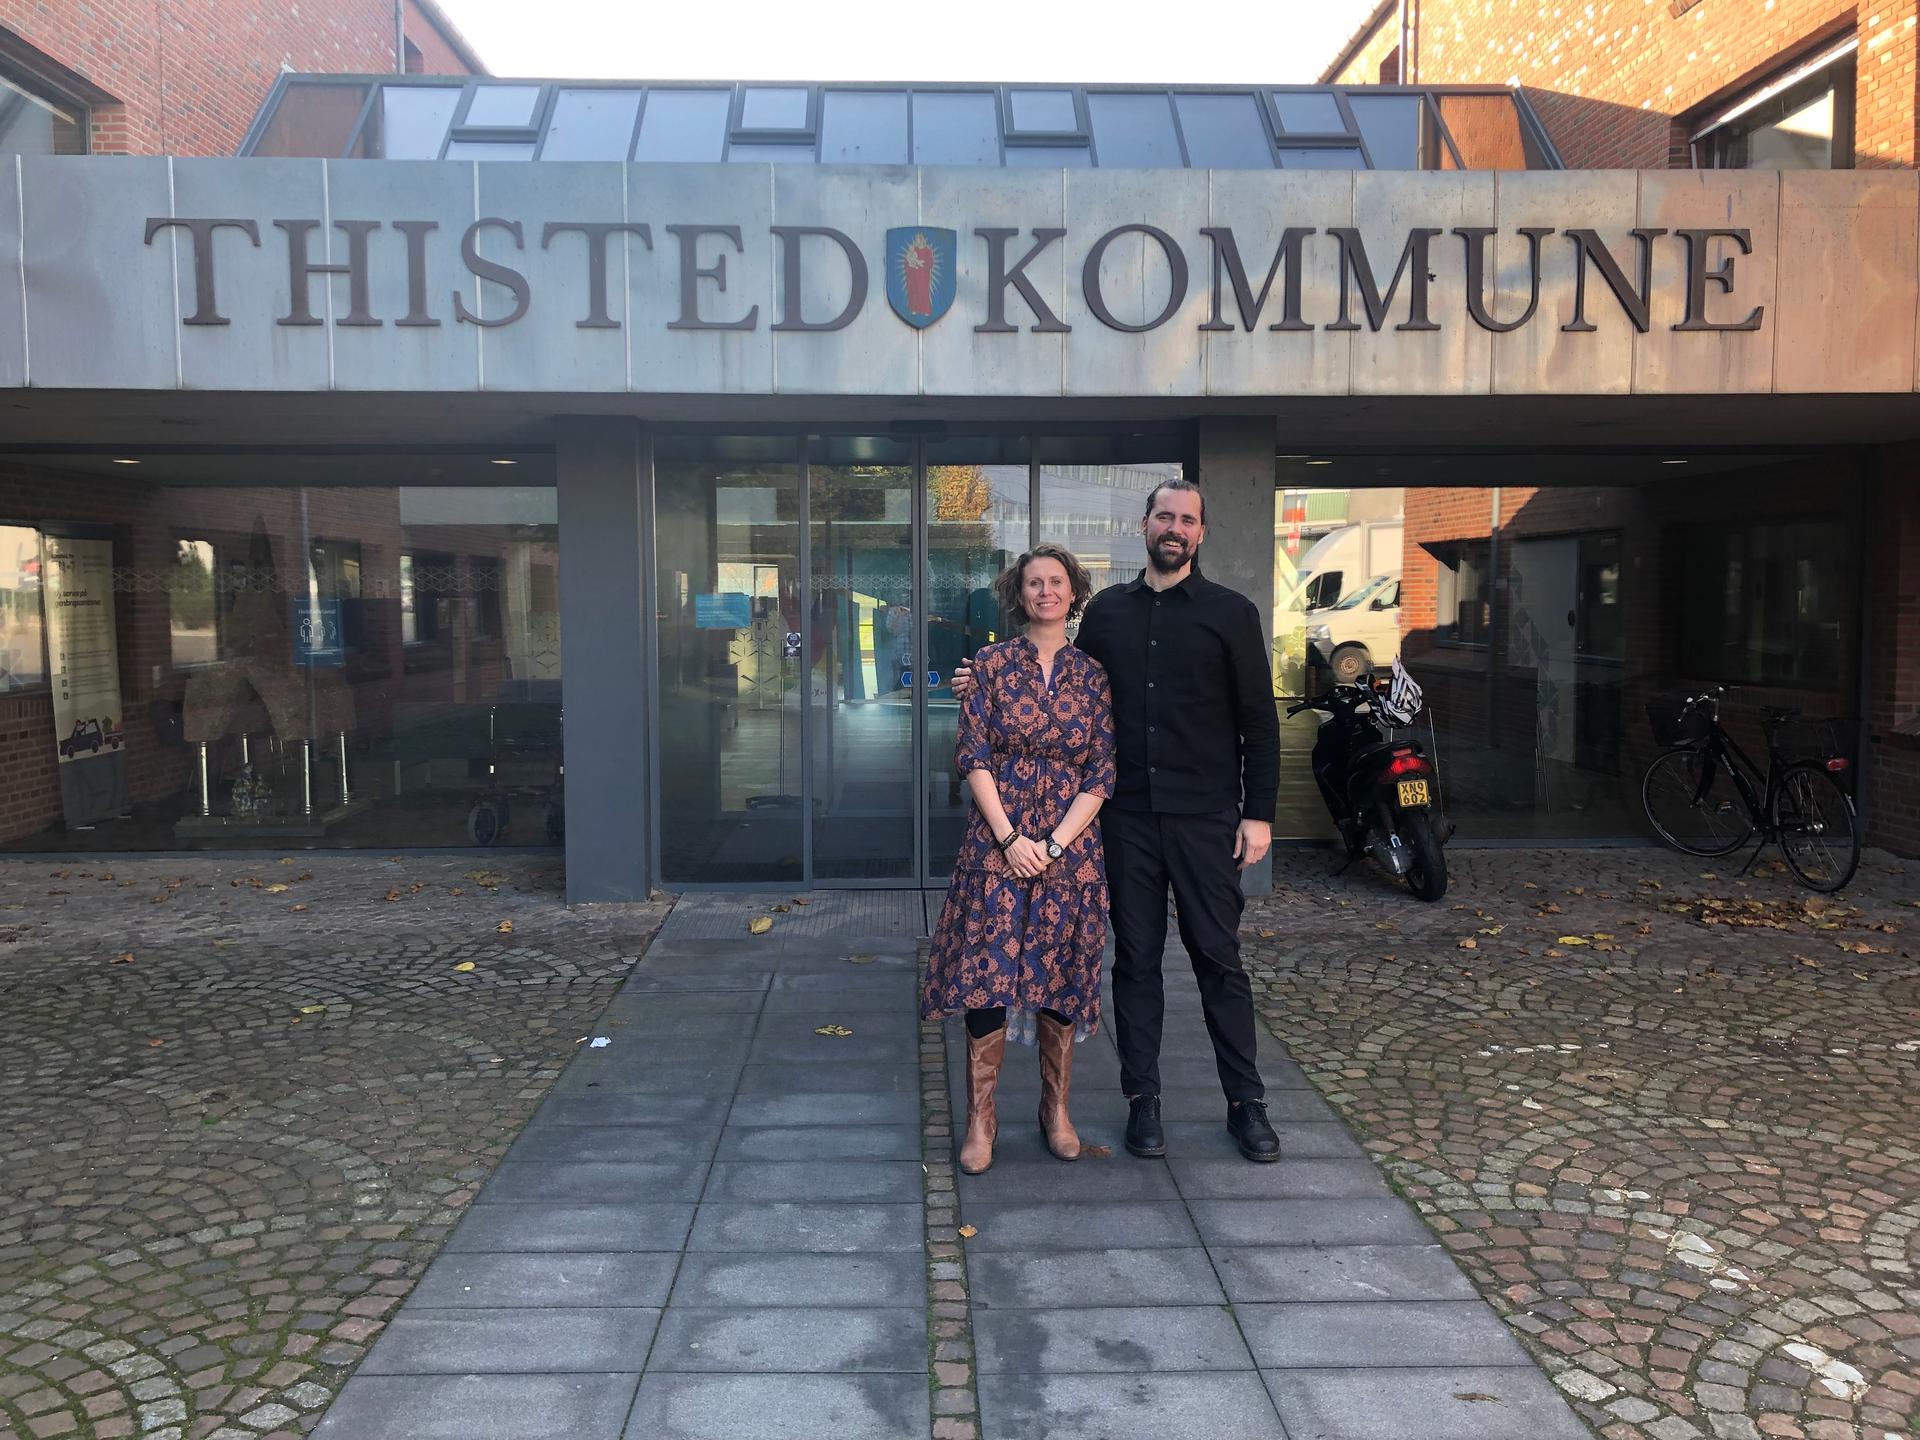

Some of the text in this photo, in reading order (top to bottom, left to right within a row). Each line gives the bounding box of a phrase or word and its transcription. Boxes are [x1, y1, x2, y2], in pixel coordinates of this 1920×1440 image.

[144, 217, 1764, 333] THISTED KOMMUNE
[1401, 782, 1424, 794] XN9
[1403, 793, 1426, 804] 602
